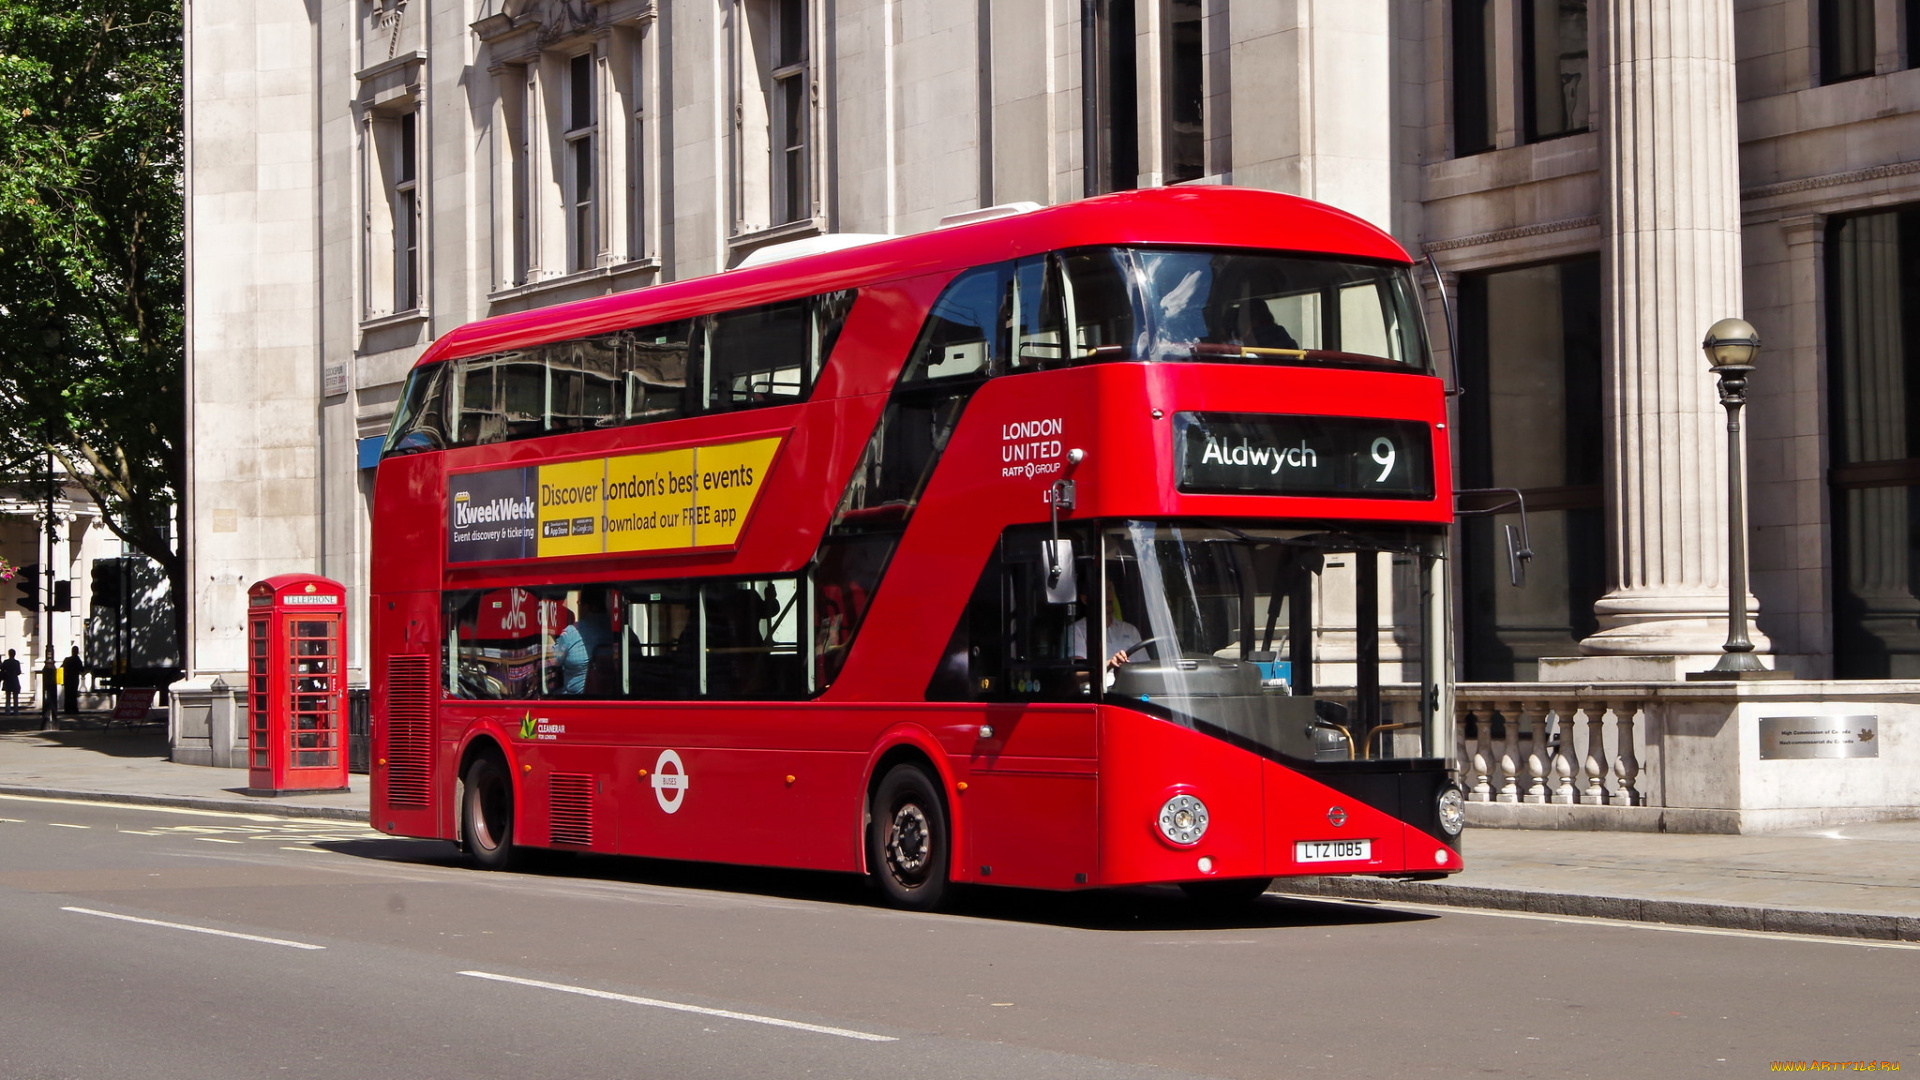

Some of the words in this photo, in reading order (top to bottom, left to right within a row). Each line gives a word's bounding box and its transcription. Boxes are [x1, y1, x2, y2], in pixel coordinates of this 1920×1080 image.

[1002, 417, 1062, 440] LONDON
[1002, 440, 1061, 462] UNITED
[1201, 436, 1317, 475] Aldwych
[1371, 437, 1396, 482] 9
[1002, 466, 1024, 477] RATP
[1035, 462, 1060, 474] GROUP
[542, 484, 598, 507] Discover
[602, 472, 664, 501] London's
[668, 469, 699, 494] best
[703, 464, 753, 491] events
[456, 496, 534, 524] KweekWeek
[602, 511, 656, 533] Download
[660, 514, 679, 528] our
[682, 505, 711, 526] FREE
[714, 507, 737, 527] app
[454, 531, 470, 542] Event
[471, 528, 500, 541] discovery
[501, 527, 507, 538] &
[286, 596, 335, 604] TELEPHONE
[1305, 843, 1330, 858] LTZ
[1334, 842, 1362, 857] 1085
